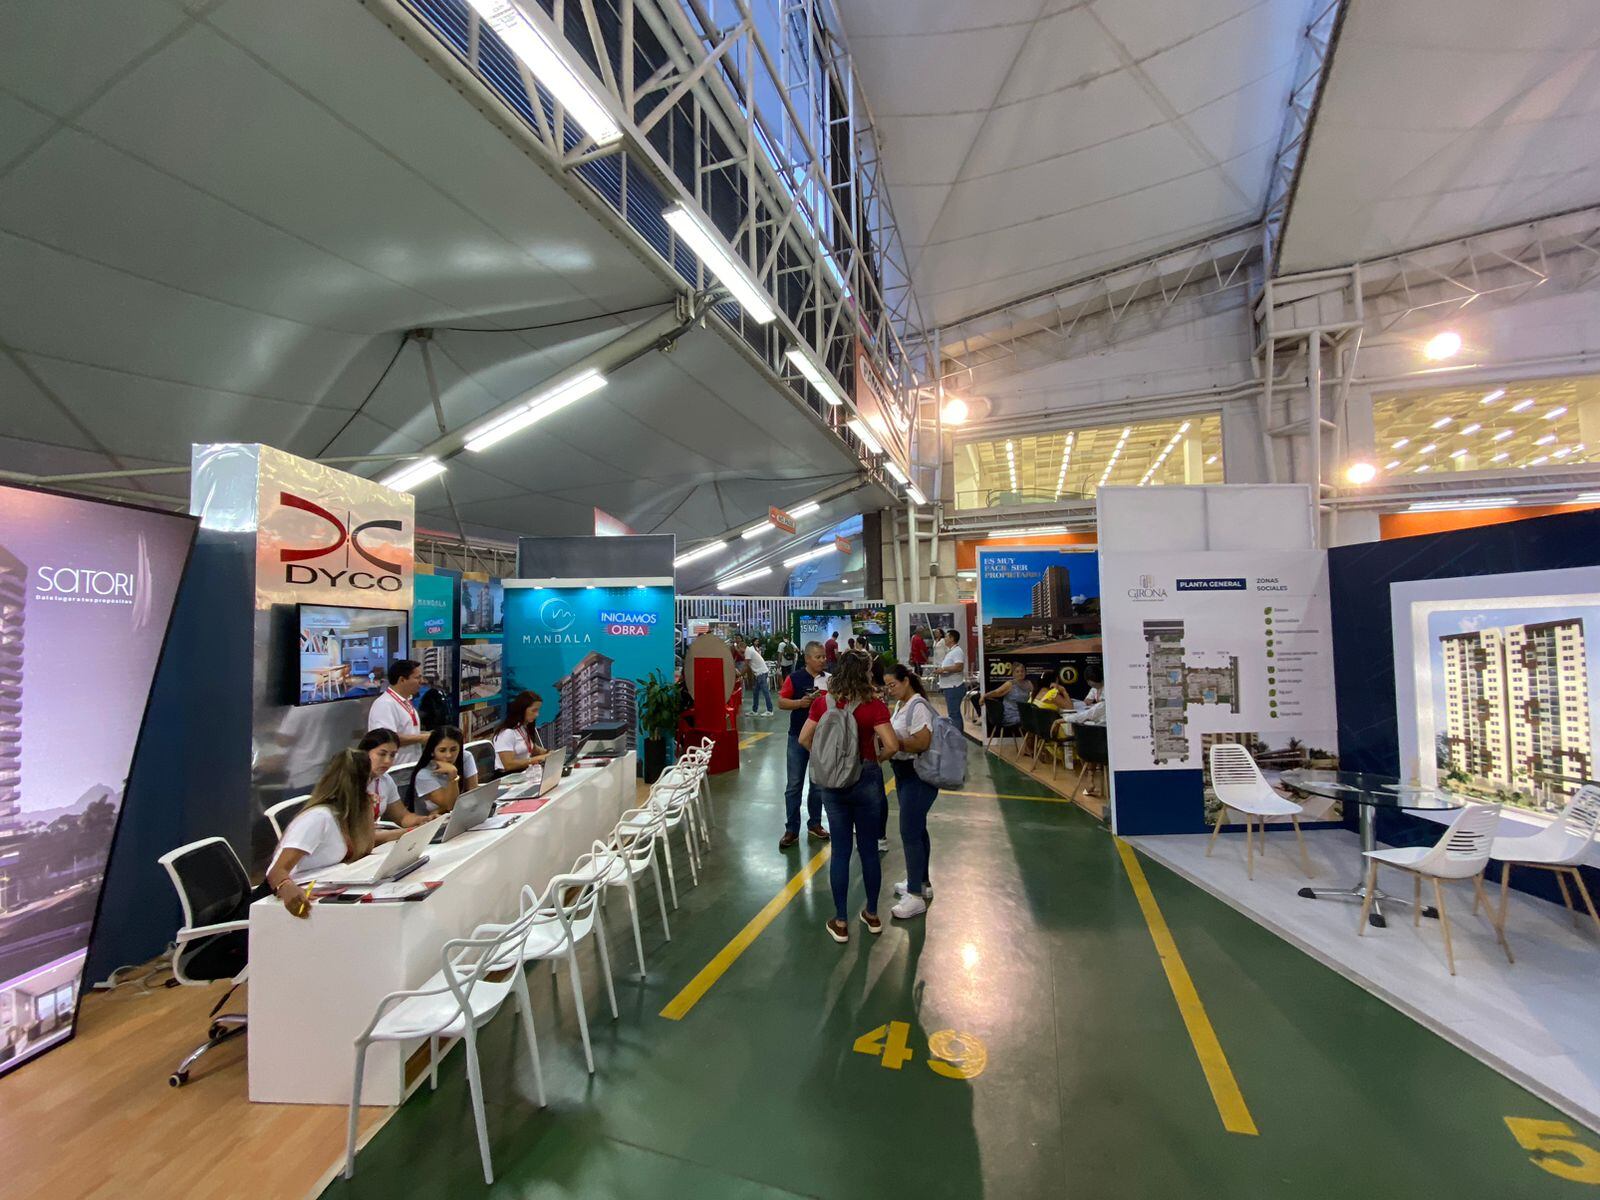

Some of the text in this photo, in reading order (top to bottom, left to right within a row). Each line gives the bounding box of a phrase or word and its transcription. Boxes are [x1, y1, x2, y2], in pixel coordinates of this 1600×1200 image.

[285, 563, 402, 592] DYCO
[1209, 580, 1242, 588] GENERAL
[1128, 589, 1168, 599] GIRONA
[601, 611, 657, 624] INICIAMOS
[611, 624, 645, 635] OBRA
[523, 633, 591, 644] MANDALA
